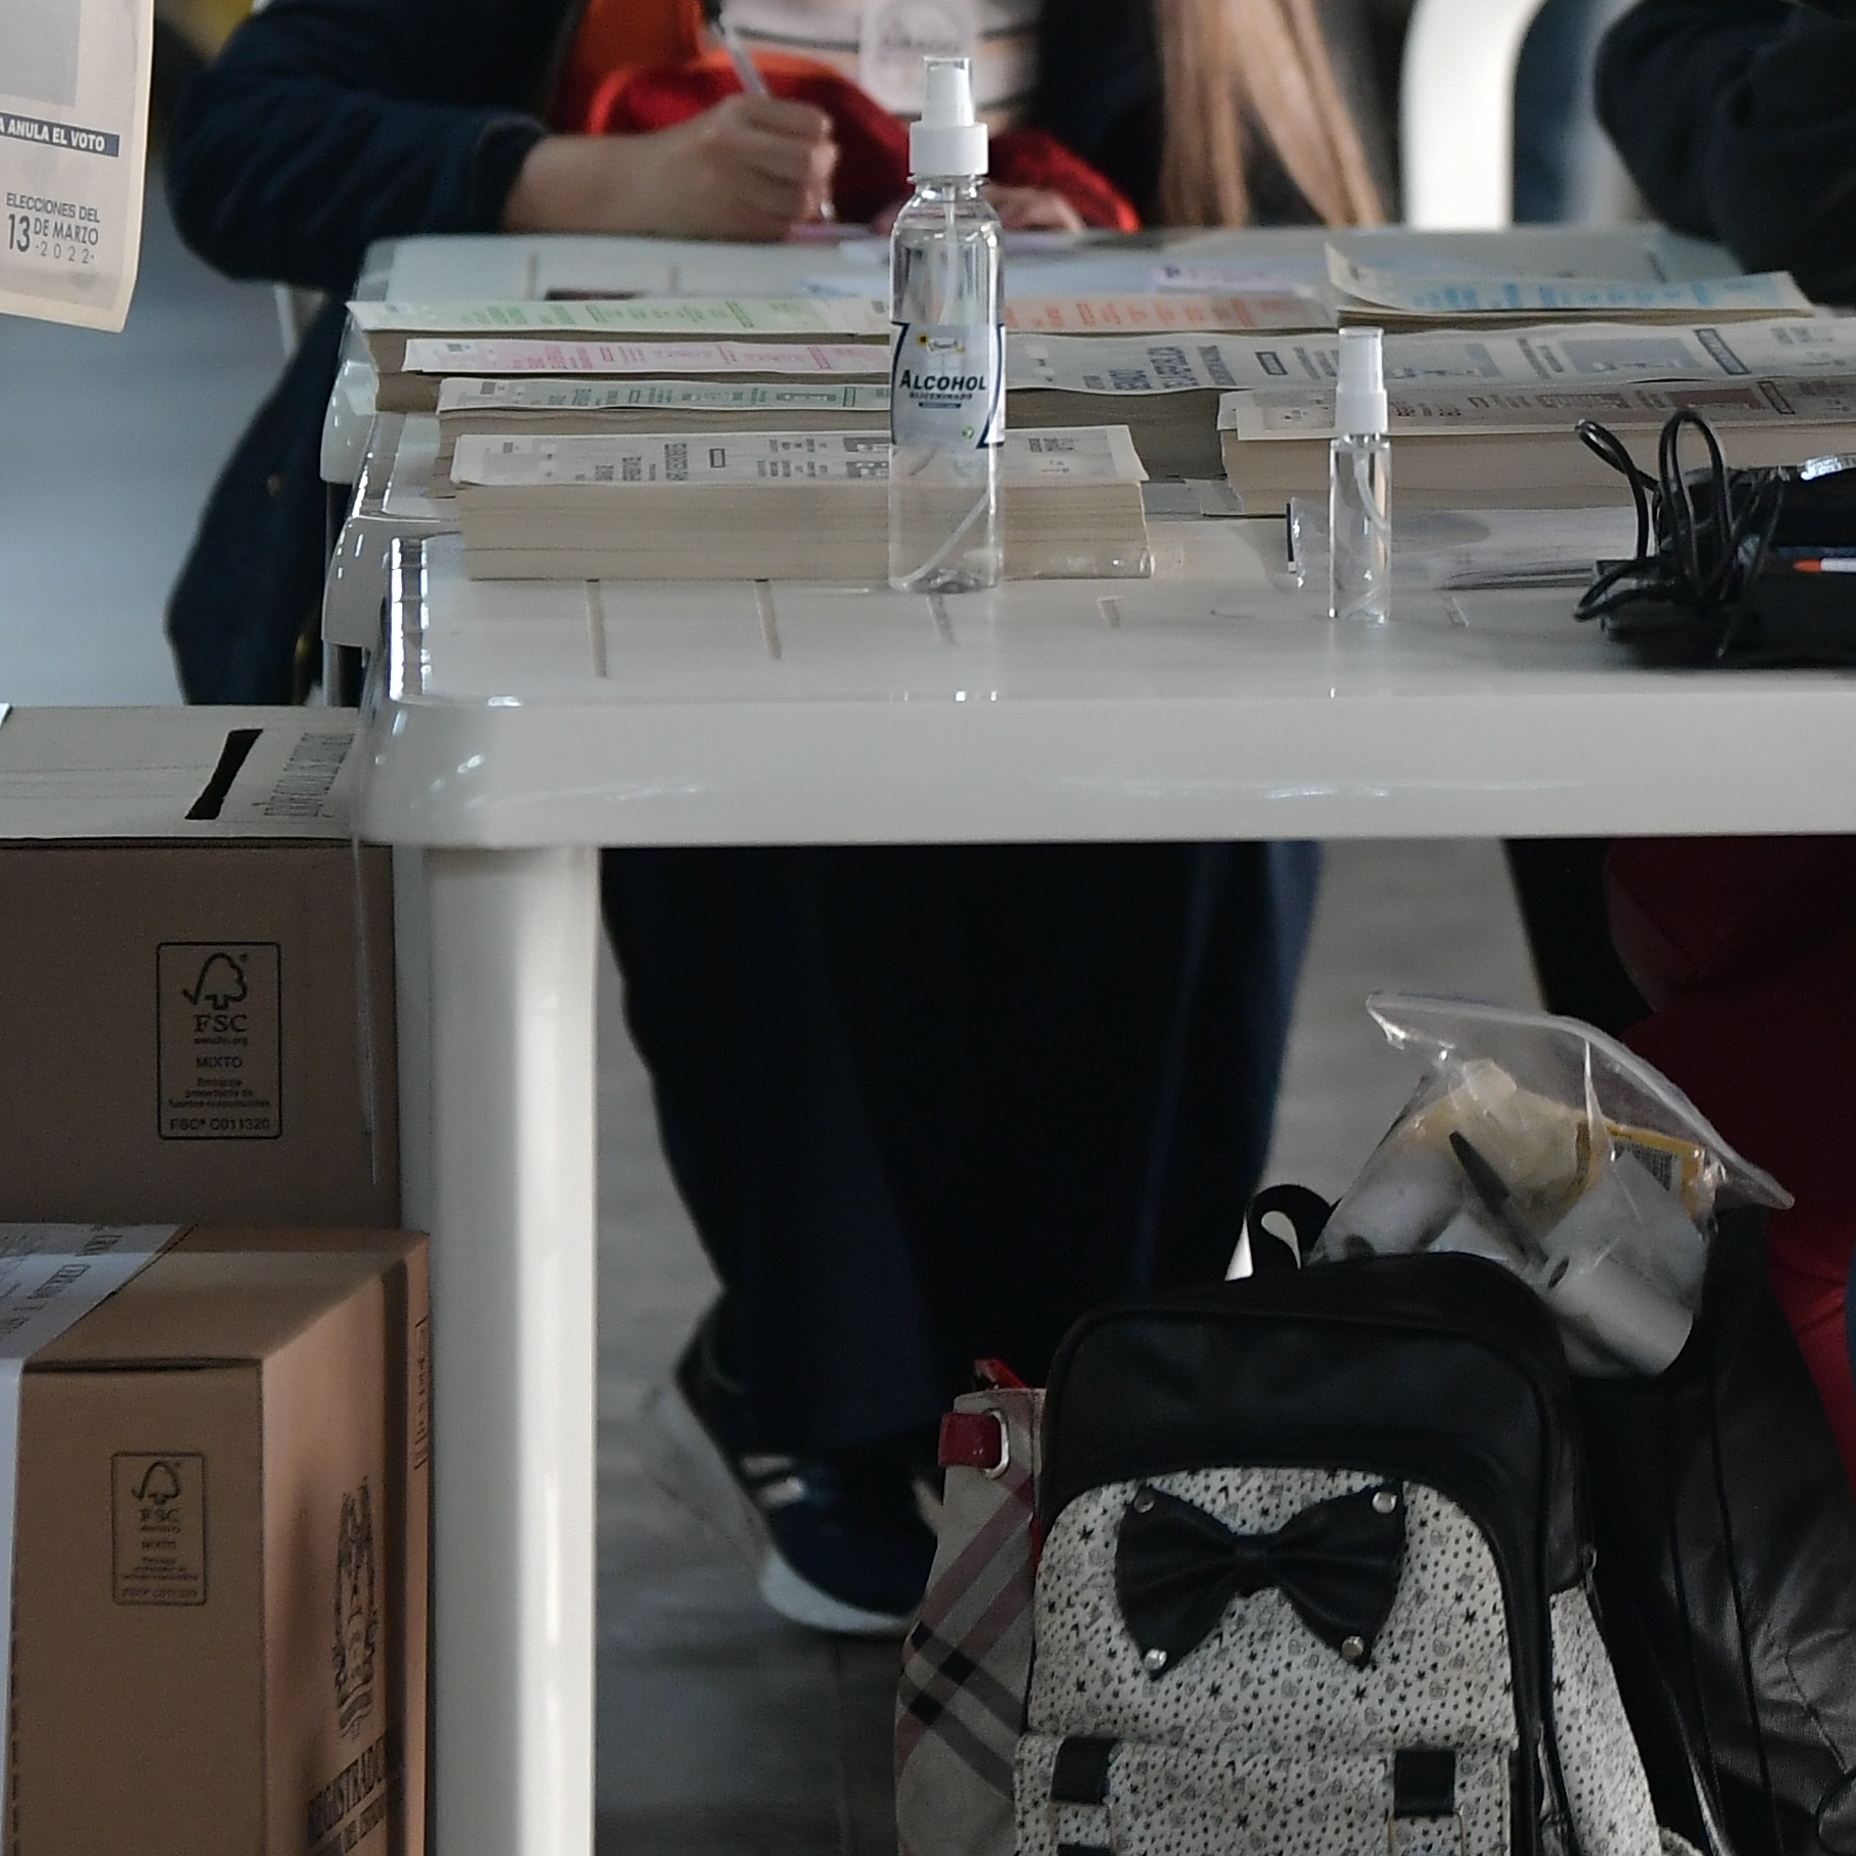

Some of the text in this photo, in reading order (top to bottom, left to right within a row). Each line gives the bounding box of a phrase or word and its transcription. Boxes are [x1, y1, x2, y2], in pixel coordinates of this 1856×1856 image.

[7, 118, 49, 142] ANULA
[52, 128, 67, 145] EL
[70, 131, 105, 151] VOTO
[6, 192, 101, 224] ELECCIONES DEL
[8, 213, 31, 252] 13
[33, 217, 99, 246] DE MARZO
[899, 369, 987, 391] ALCOHOL
[194, 1014, 247, 1033] FSC
[196, 1056, 243, 1069] MIXTO
